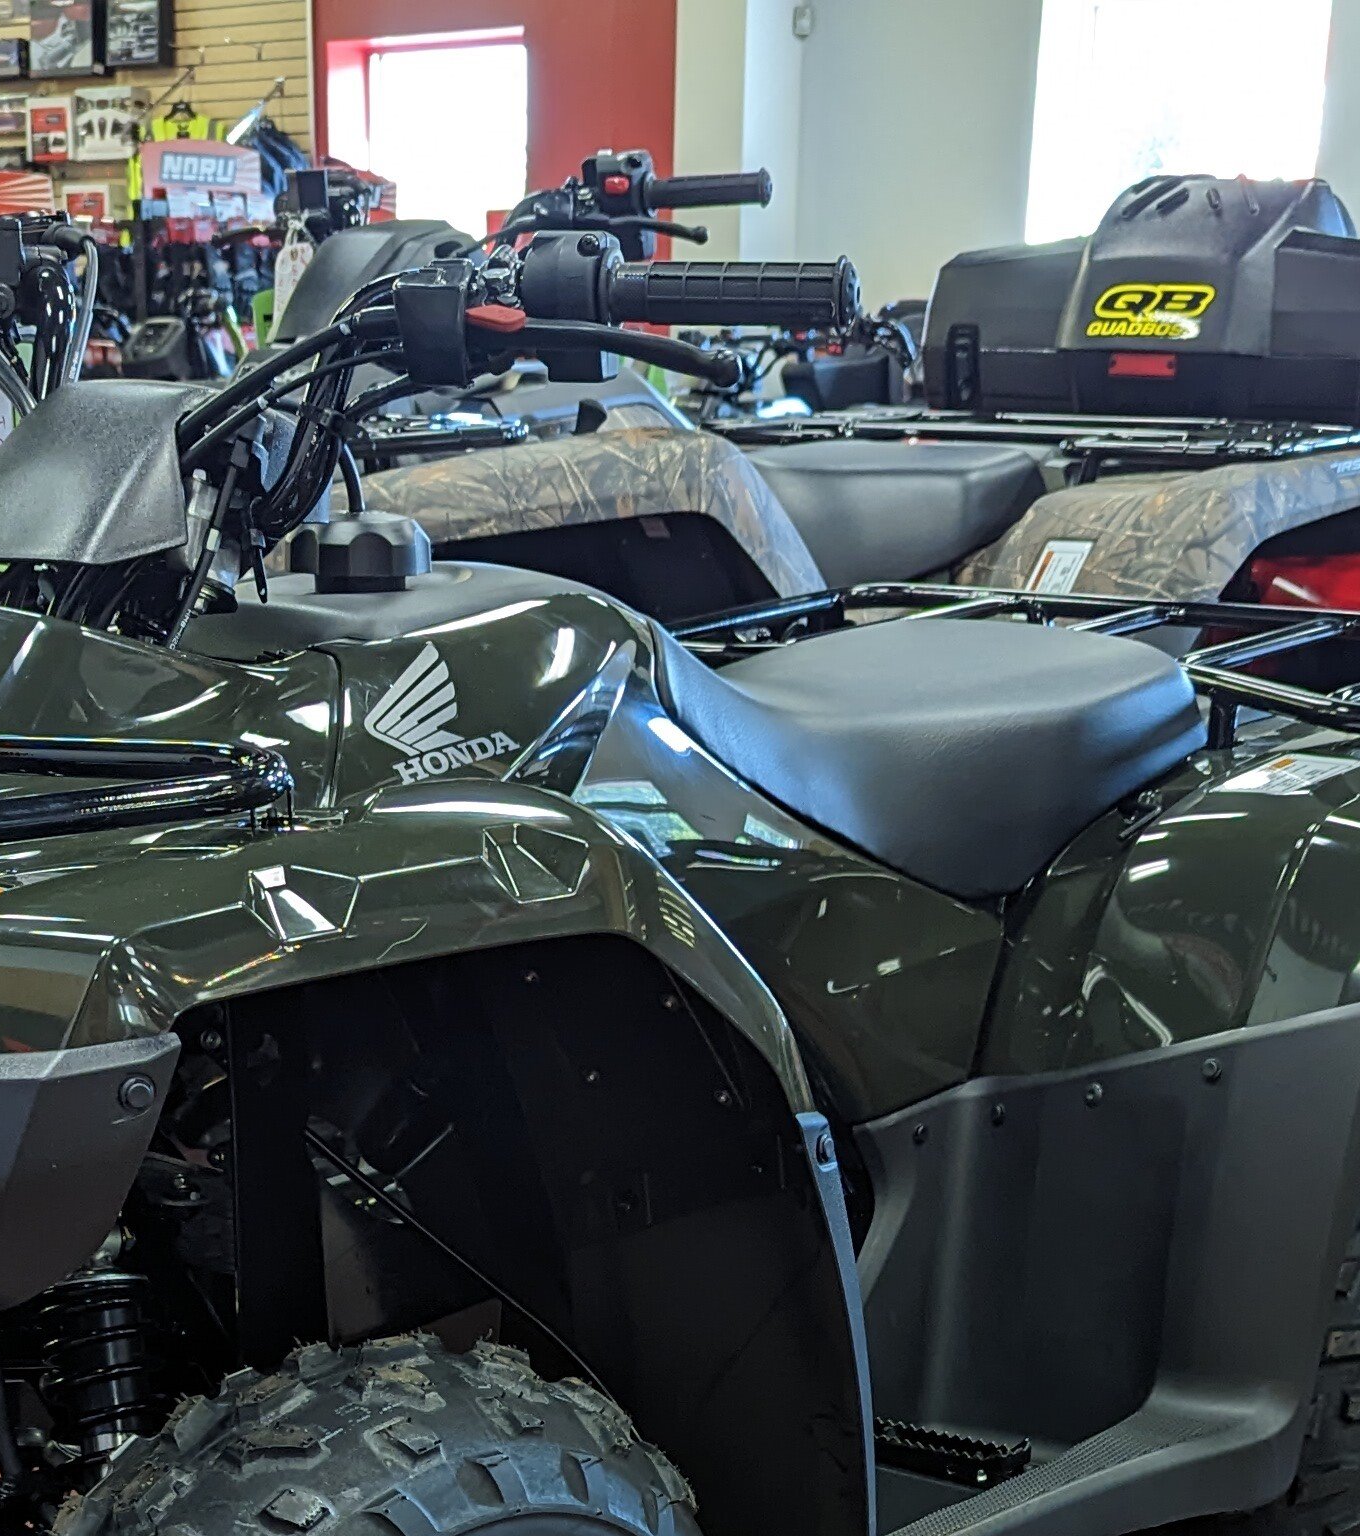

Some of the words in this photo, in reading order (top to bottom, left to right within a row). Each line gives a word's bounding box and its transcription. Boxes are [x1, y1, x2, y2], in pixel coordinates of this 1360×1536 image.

[162, 154, 236, 184] NORU
[1096, 285, 1215, 318] QB
[1085, 320, 1196, 337] QUADBOS
[392, 730, 520, 786] HONDA
